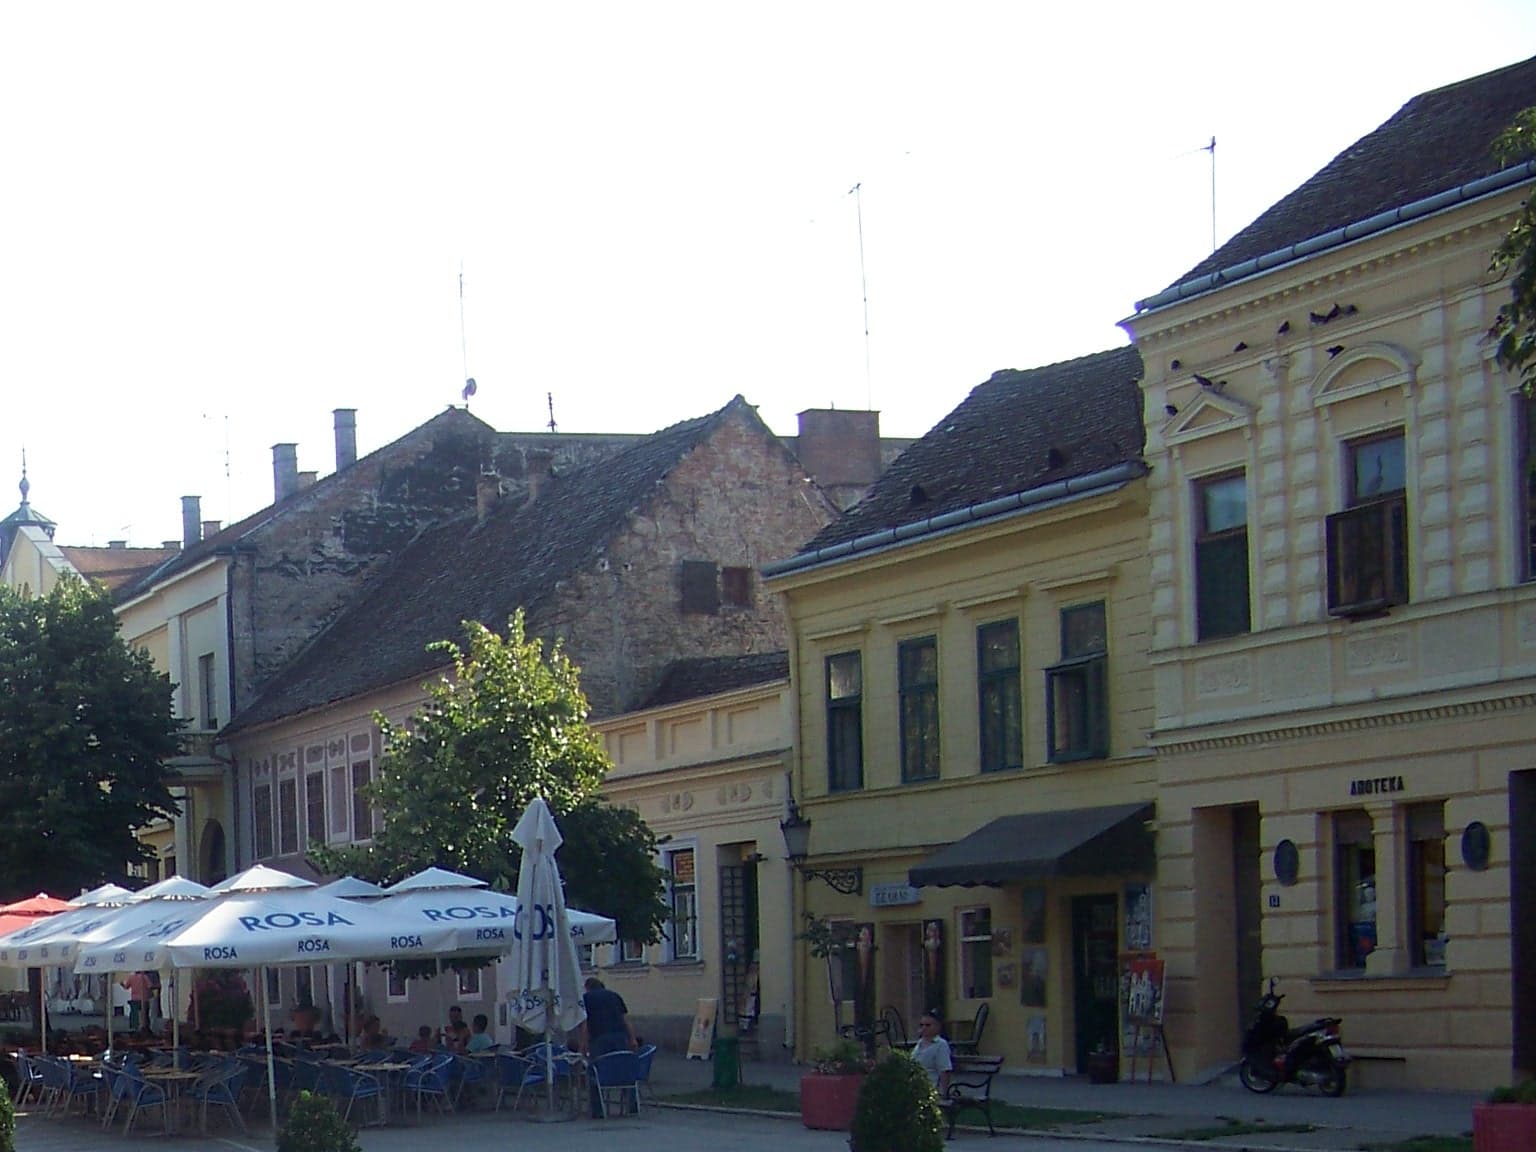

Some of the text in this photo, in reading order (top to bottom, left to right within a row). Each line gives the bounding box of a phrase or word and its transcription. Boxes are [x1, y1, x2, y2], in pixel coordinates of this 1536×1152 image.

[422, 906, 515, 922] ROSA
[239, 911, 355, 932] ROSA
[476, 928, 505, 941] ROSA
[570, 925, 585, 937] SA
[298, 939, 331, 953] ROSA
[391, 935, 423, 949] ROSA
[204, 947, 238, 961] ROSA
